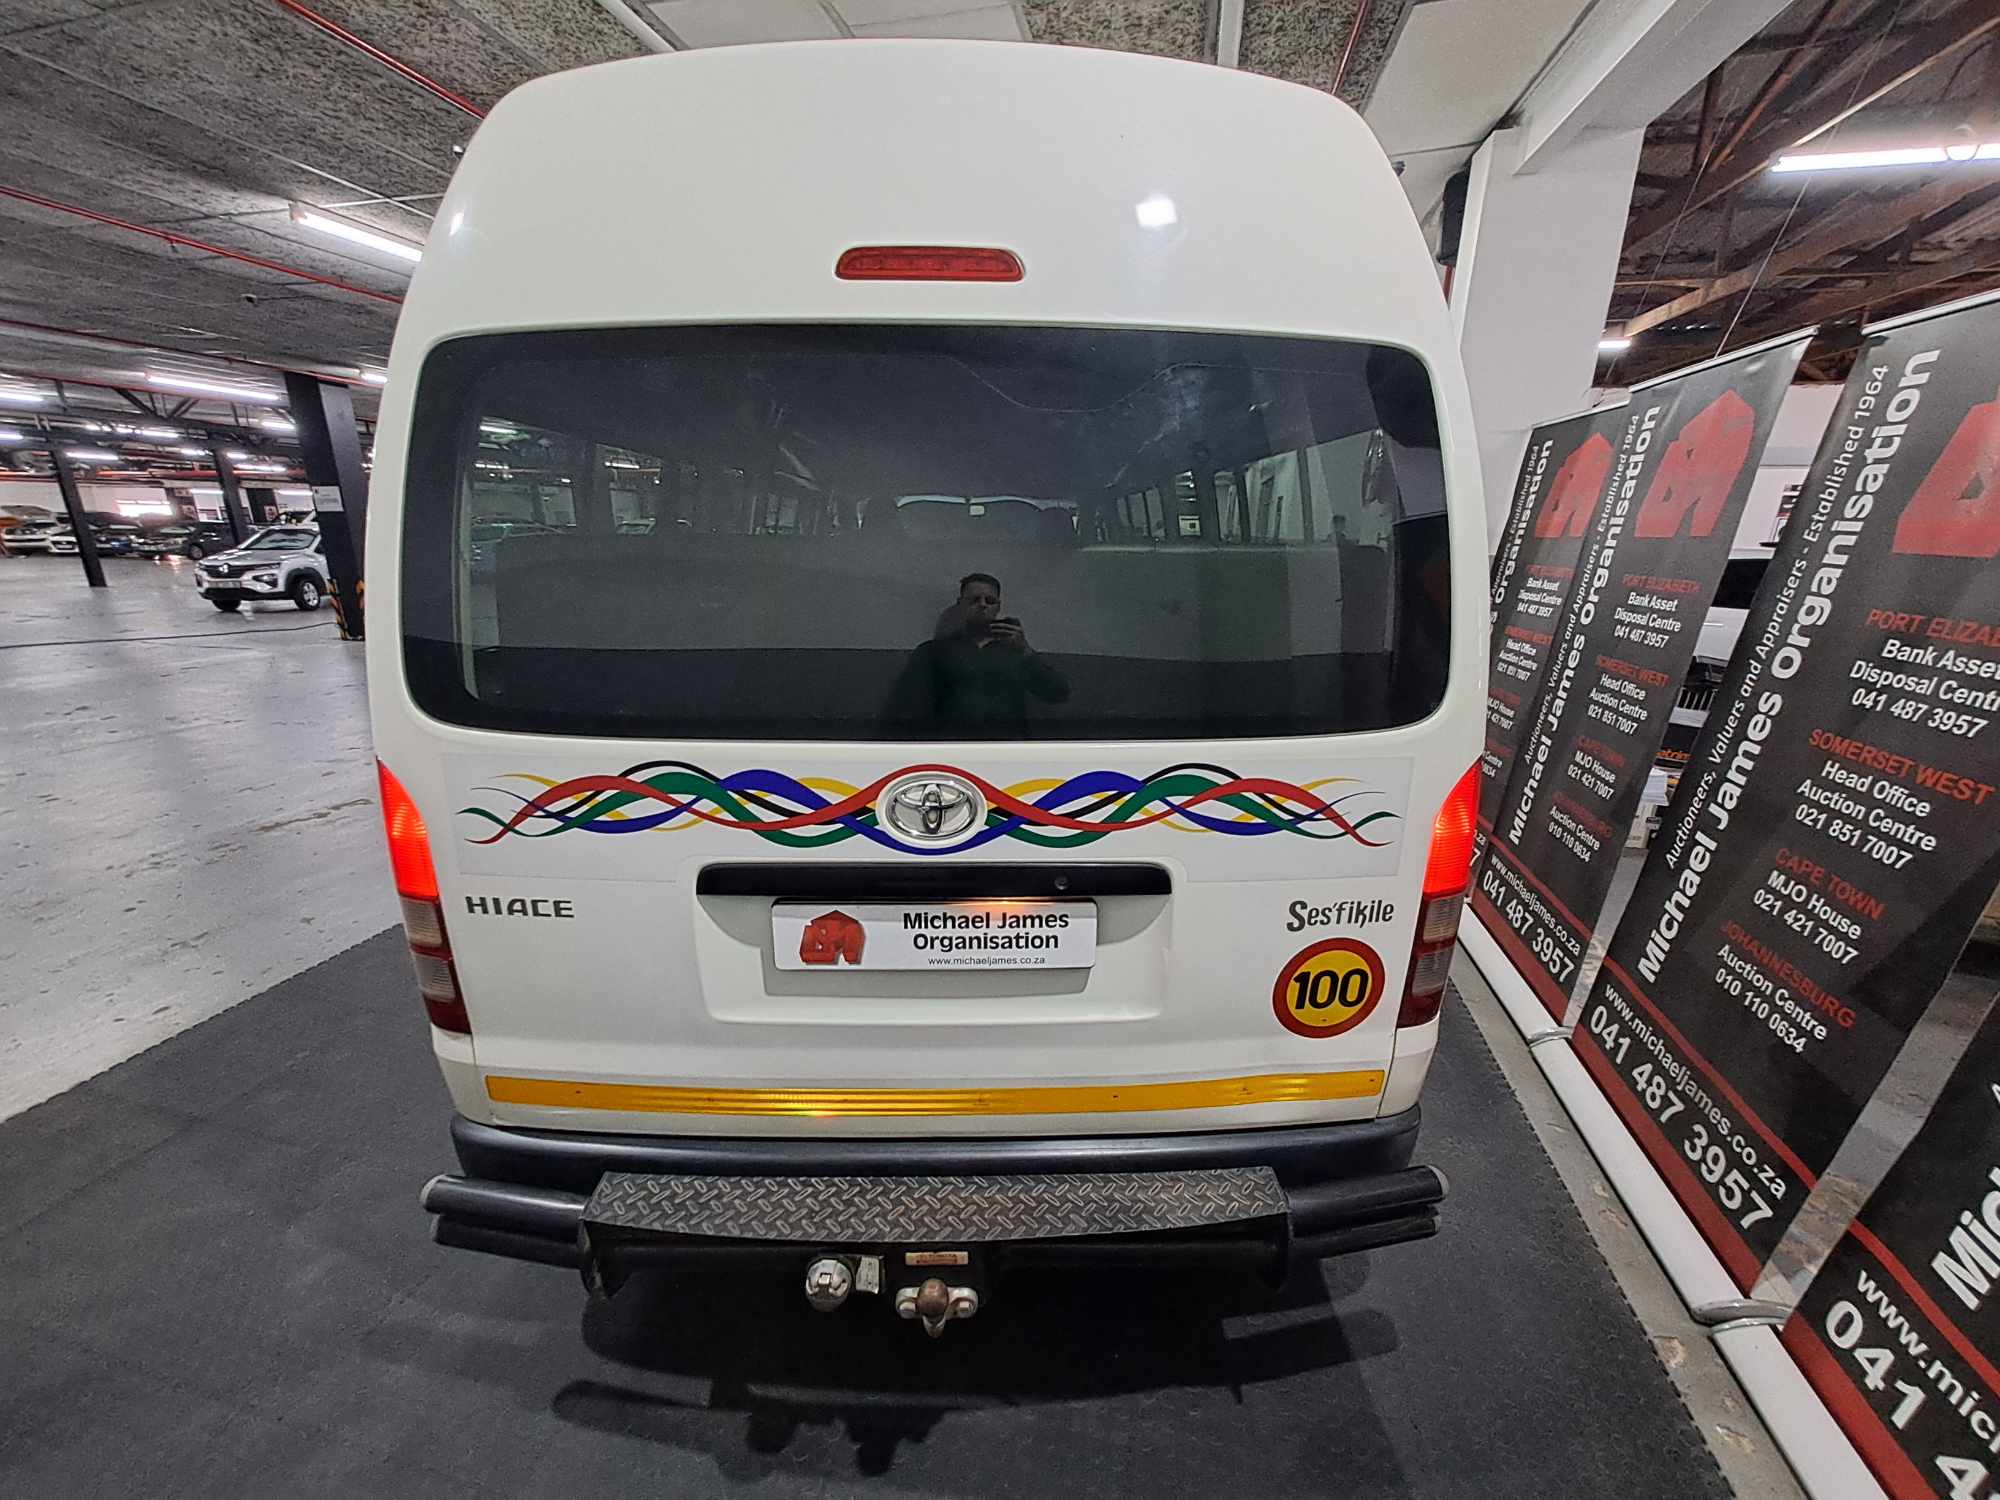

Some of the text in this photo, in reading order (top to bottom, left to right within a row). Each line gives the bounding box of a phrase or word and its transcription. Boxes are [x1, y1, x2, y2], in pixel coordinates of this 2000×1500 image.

[1495, 440, 1553, 603] Organisation
[1524, 692, 1554, 764] Auctioneers,
[1547, 643, 1568, 688] Valuers
[1565, 614, 1576, 640] and
[1573, 544, 1599, 613] Appraisers
[1597, 454, 1628, 532] Established
[1623, 415, 1640, 450] 1964
[1627, 591, 1679, 612] Bank Asset
[1665, 770, 1717, 869] Auctioneers,
[1708, 700, 1745, 764] Valuers
[1740, 659, 1762, 697] and
[1755, 559, 1806, 659] Appraisers
[1803, 425, 1864, 542] Established
[1854, 365, 1889, 420] 1964
[1508, 406, 1661, 846] Michael James Organisation
[1613, 607, 1682, 632] Disposal Centre
[1614, 625, 1670, 648] 041 487 3957
[1865, 608, 1926, 634] PORT
[1637, 830, 1718, 984] Michael
[1708, 691, 1783, 830] James
[1771, 349, 1942, 680] Organisation
[1850, 660, 1938, 696] Disposal
[1881, 638, 1939, 667] Bank
[1588, 687, 1649, 721] Auction Centre
[1600, 673, 1647, 700] Head Office
[1851, 687, 1989, 738] 041 487 3957
[1587, 704, 1639, 735] 021 851 7007
[1567, 764, 1615, 800] 021 421 7007
[1574, 750, 1592, 768] MJO
[1592, 760, 1616, 783] House
[1809, 728, 1996, 806] SOMERSET WEST
[1821, 760, 1932, 818] Head Office
[1548, 821, 1562, 838] 010
[1573, 839, 1592, 862] 0634
[1549, 806, 1577, 830] Auction
[1576, 824, 1600, 851] Centre
[1795, 804, 1913, 870] 021 851 7007
[1797, 779, 1937, 852] Auction Centre
[465, 896, 575, 918] HIACE
[1491, 854, 1580, 956] www.michaeljames.co.za
[1767, 870, 1862, 940] MJO House
[1775, 847, 1885, 922] CAPE TOWN
[902, 911, 1069, 930] Michael James
[912, 932, 1060, 953] Organisation
[1483, 870, 1575, 982] 041 487 3957
[1753, 888, 1859, 965] 021 421 7007
[928, 955, 1046, 968] www.michaeljames.co.za
[1293, 968, 1370, 1010] 100
[1721, 920, 1857, 1029] JOHANNESBURG
[1715, 968, 1808, 1053] 010 110 0634
[1718, 944, 1828, 1040] Auction Centre
[1590, 1004, 1774, 1231] 041 487 3957
[1604, 984, 1788, 1200] www.michaeljames.co.za
[1825, 1300, 1927, 1430] 041
